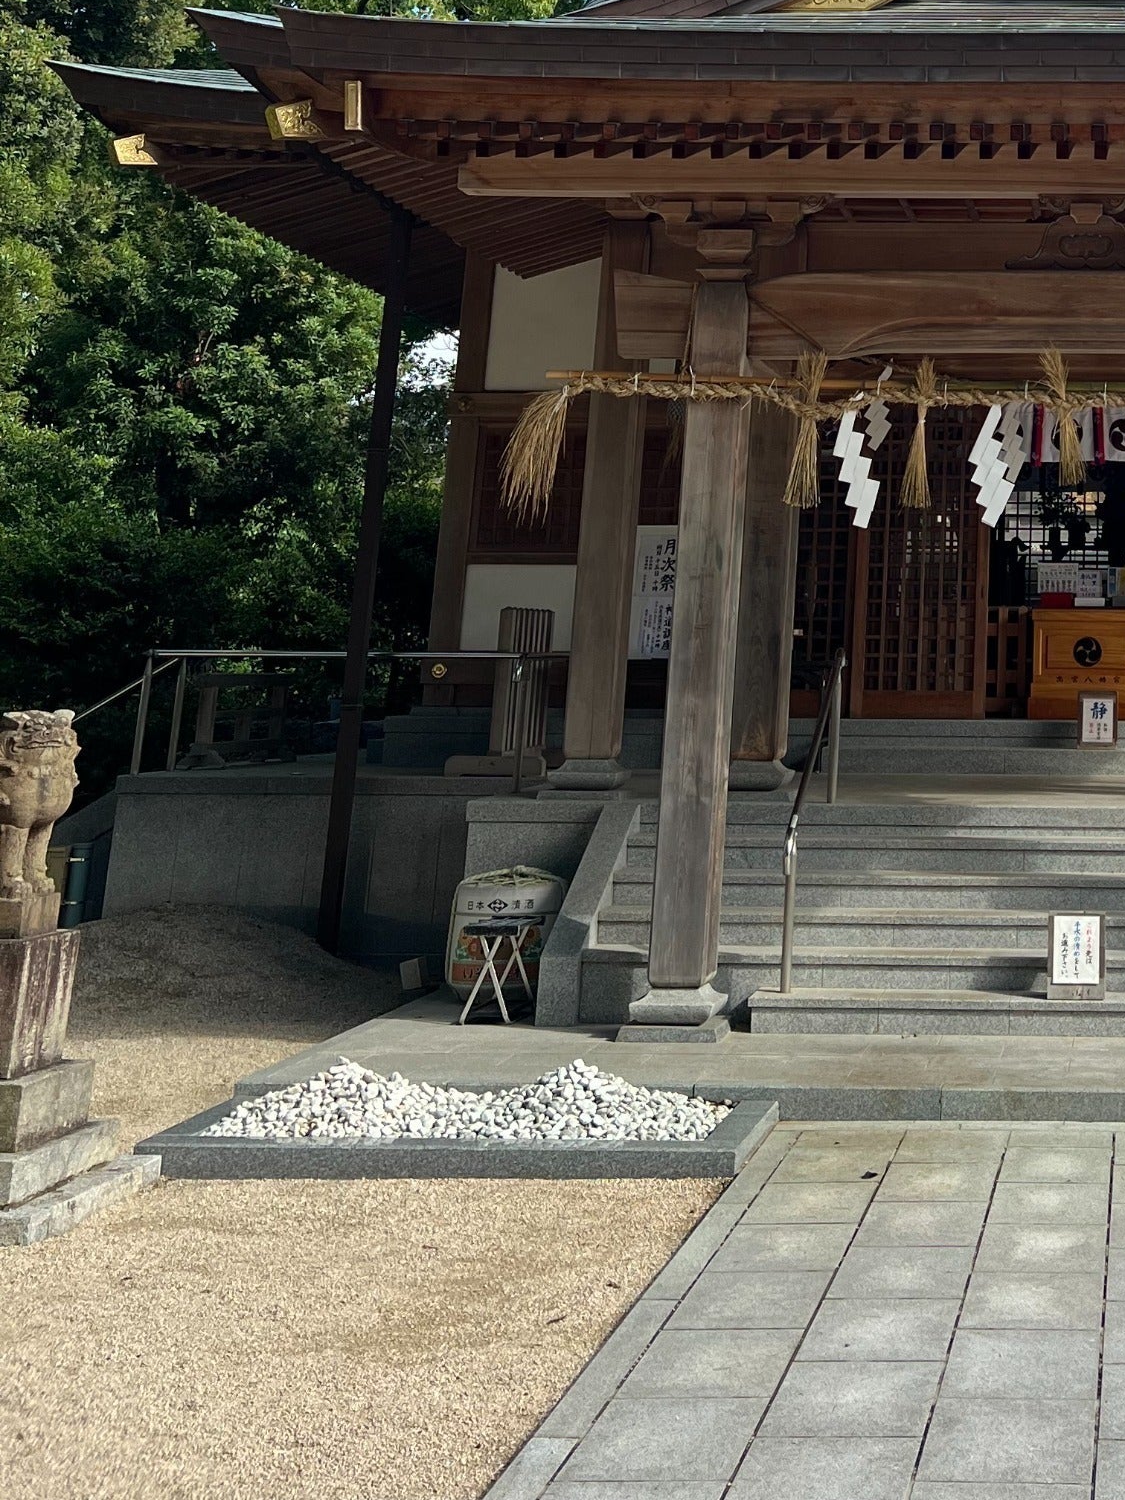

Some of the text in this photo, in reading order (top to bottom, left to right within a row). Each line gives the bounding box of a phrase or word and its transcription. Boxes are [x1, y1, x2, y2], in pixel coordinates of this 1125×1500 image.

[659, 539, 676, 592] 月次祭
[1091, 702, 1108, 719] 静
[467, 899, 534, 911] 日本 清酒
